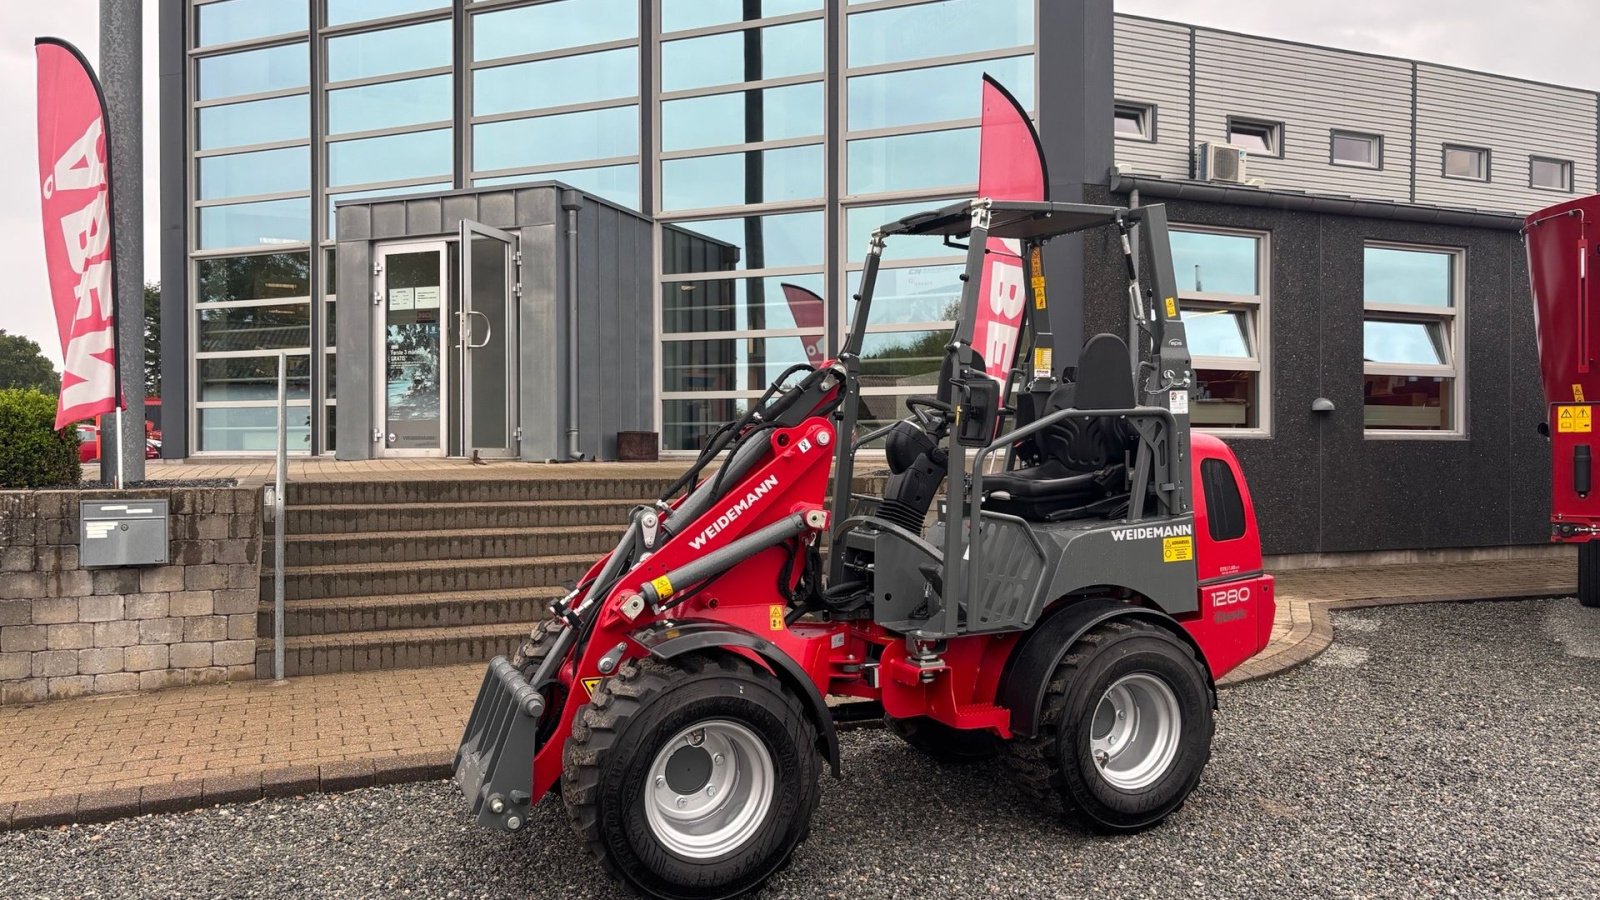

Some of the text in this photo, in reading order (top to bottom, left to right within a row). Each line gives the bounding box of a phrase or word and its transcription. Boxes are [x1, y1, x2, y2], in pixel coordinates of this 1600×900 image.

[688, 474, 779, 550] WEIDEMANN
[1111, 524, 1192, 541] WEIDEMANN
[1211, 587, 1250, 607] 1280
